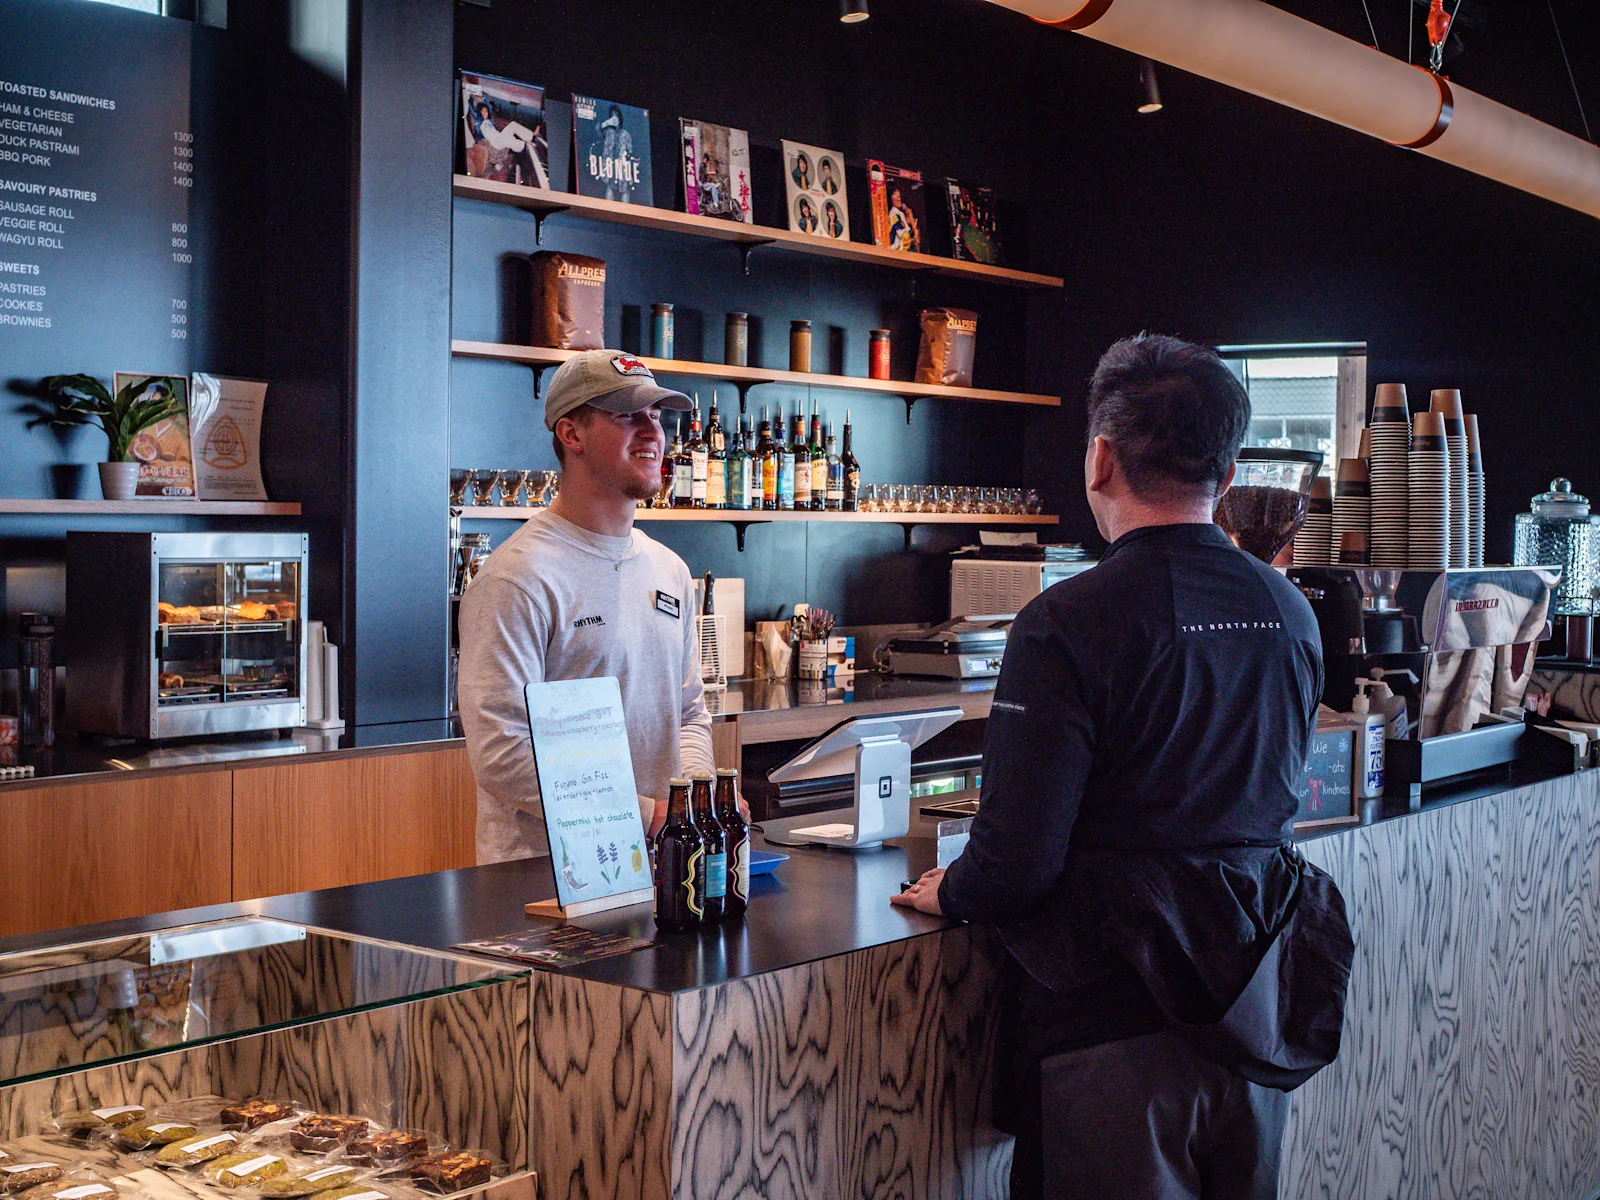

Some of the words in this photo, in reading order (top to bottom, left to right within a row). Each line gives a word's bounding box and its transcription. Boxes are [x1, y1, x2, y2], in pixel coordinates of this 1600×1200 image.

[0, 80, 46, 98] TOASTED
[50, 90, 115, 110] SANDWICHES
[24, 105, 30, 116] &
[33, 108, 74, 123] CHEESE
[0, 119, 62, 137] VEGETARIAN
[173, 132, 194, 143] 1300
[30, 139, 80, 156] PASTRAMI
[173, 146, 193, 158] 1300
[22, 154, 51, 166] PORK
[172, 161, 193, 172] 1400
[590, 154, 640, 183] BLONDE
[172, 176, 193, 187] 1400
[0, 180, 46, 195] SAVOURY
[49, 187, 97, 202] PASTRIES
[49, 206, 74, 219] ROLL
[39, 222, 65, 234] ROLL
[172, 223, 187, 233] 800
[37, 237, 64, 249] ROLL
[172, 238, 187, 248] 800
[172, 253, 192, 263] 1000
[0, 262, 40, 275] SWEETS
[172, 299, 187, 309] 700
[172, 314, 187, 324] 500
[172, 329, 186, 339] 500
[574, 616, 603, 628] RHYTHM
[1313, 740, 1328, 753] We
[582, 773, 592, 784] Gin
[1322, 782, 1350, 795] kindness
